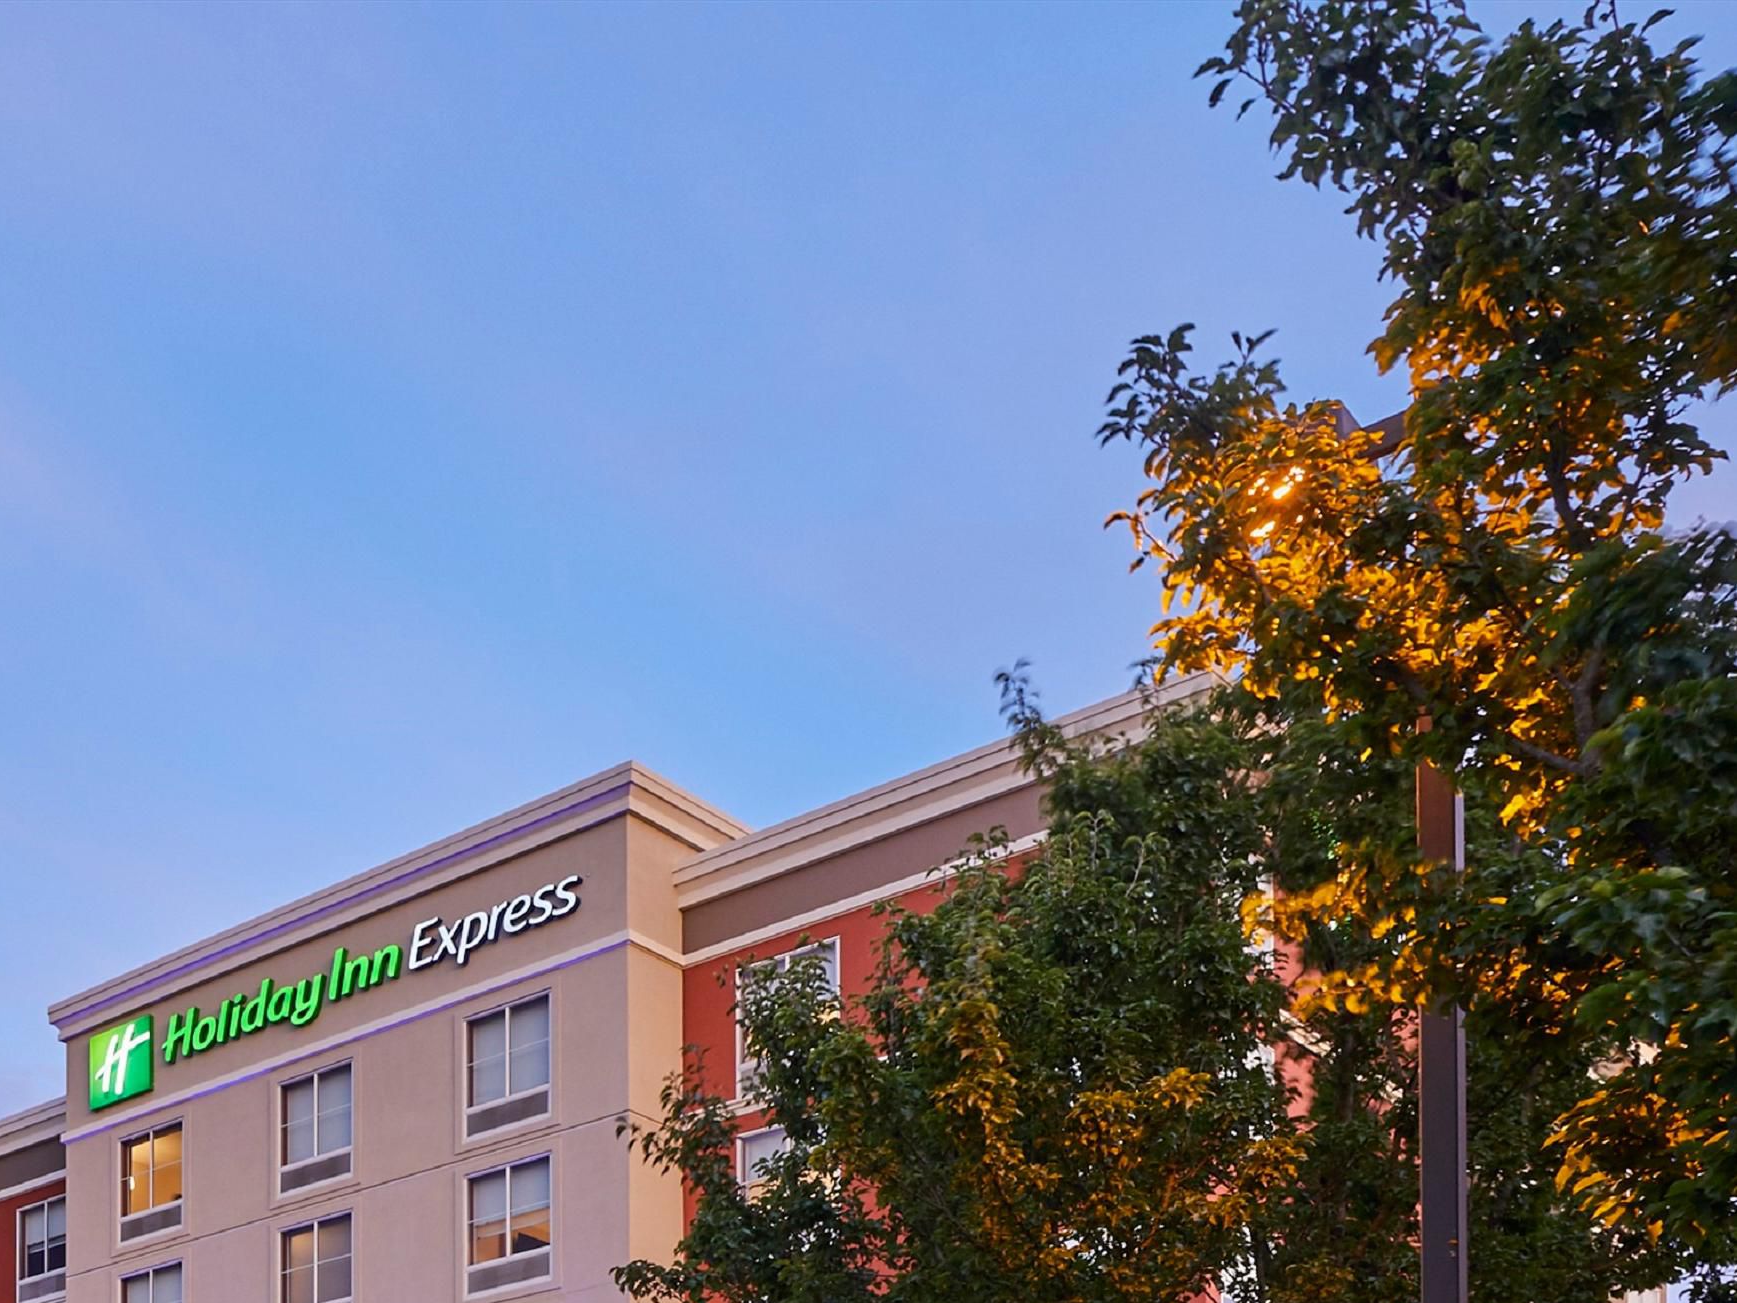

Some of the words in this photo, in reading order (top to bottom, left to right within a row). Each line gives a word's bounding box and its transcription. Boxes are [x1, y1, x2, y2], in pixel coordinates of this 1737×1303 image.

[161, 973, 325, 1063] Holiday
[328, 944, 401, 1001] Inn
[407, 874, 580, 970] Express
